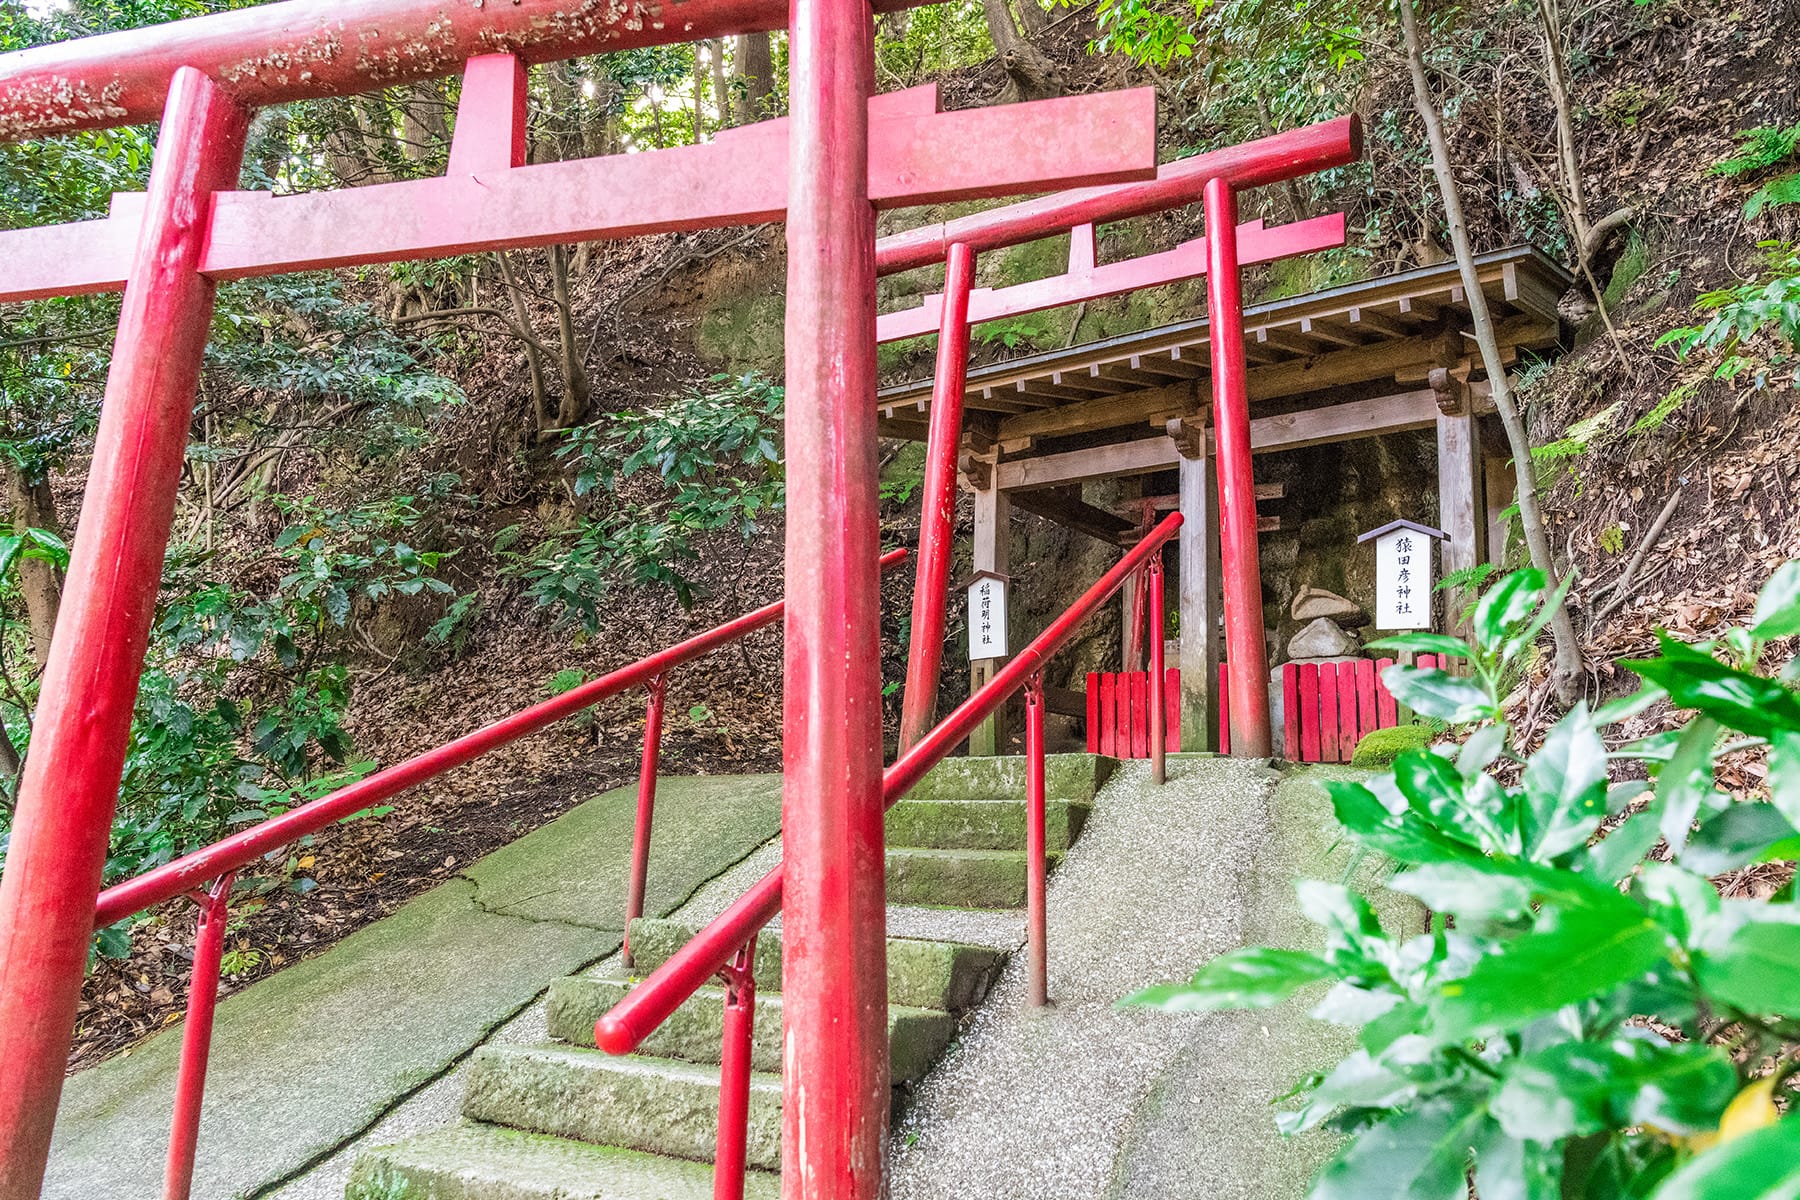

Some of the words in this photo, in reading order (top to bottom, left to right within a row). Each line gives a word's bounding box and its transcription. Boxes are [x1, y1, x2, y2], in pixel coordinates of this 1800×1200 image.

[1394, 537, 1412, 614] 猿田彦神社
